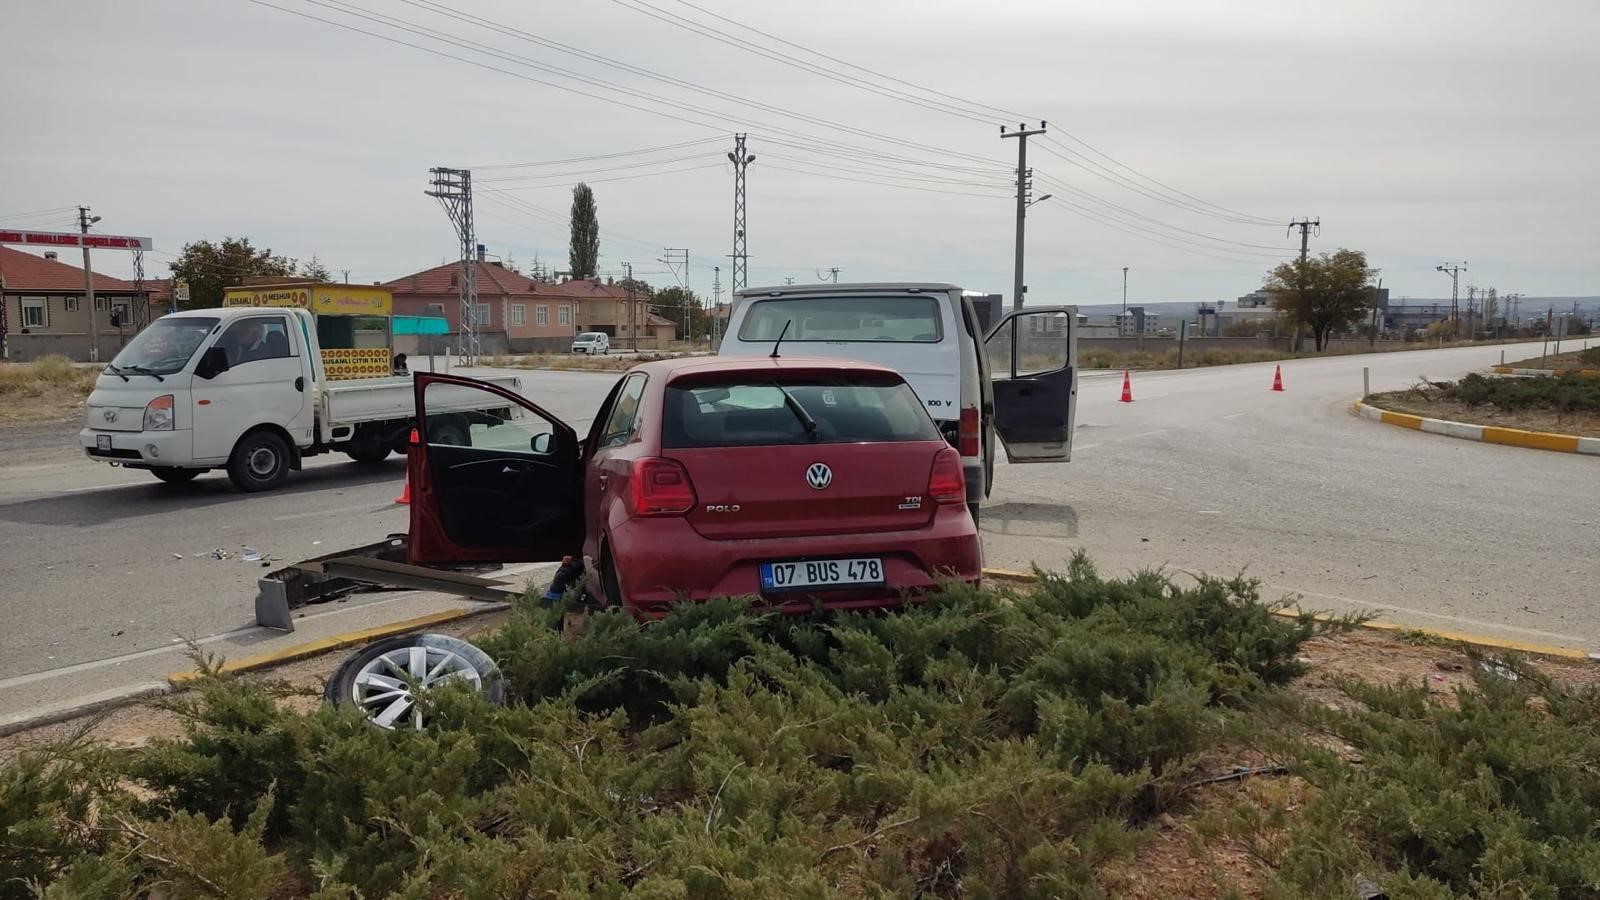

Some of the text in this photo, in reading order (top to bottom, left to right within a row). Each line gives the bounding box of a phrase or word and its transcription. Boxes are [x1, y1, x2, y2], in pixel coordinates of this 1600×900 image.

[945, 400, 953, 408] V
[904, 496, 922, 504] TDI
[706, 504, 741, 513] POLO
[774, 560, 880, 585] 07 BUS 478
